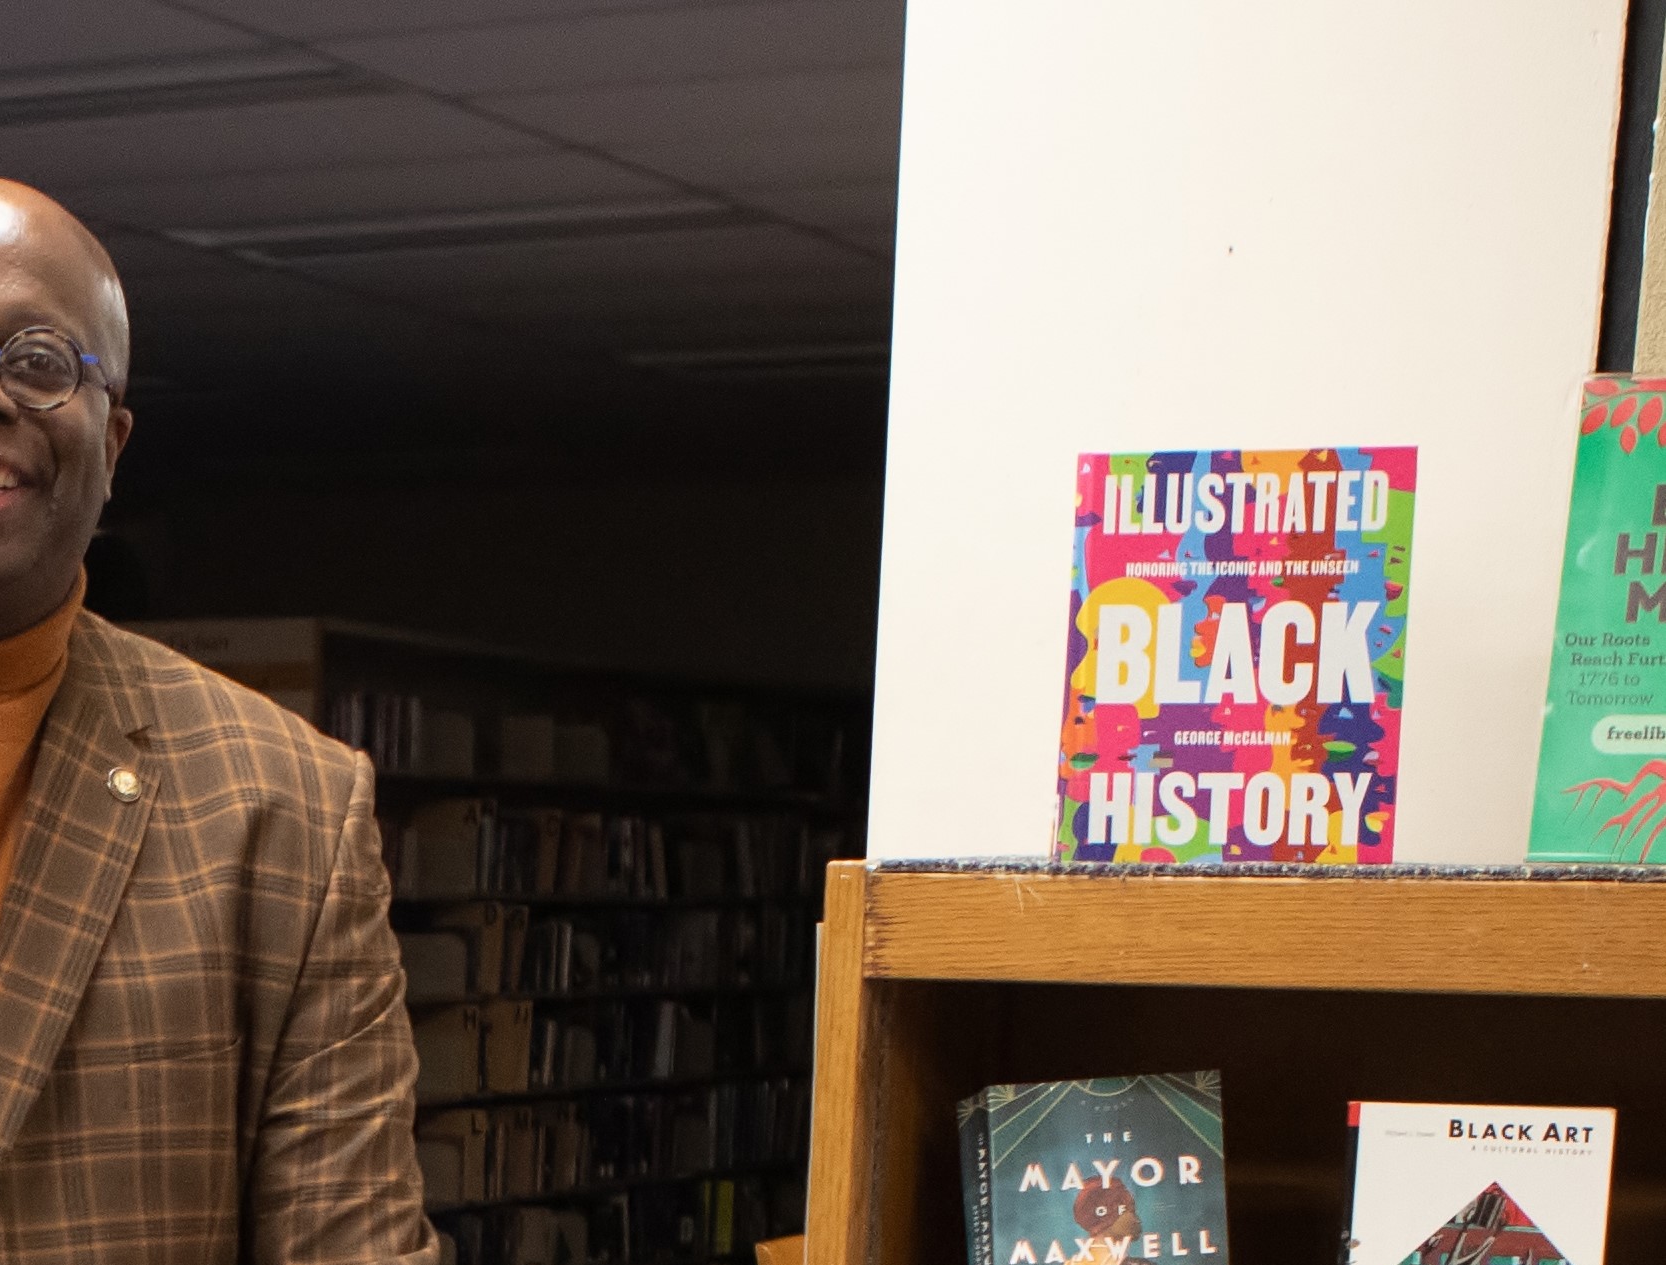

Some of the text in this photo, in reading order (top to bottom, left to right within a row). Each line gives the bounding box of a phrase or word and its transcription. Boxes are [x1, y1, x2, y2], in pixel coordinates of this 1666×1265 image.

[1103, 470, 1389, 535] ILLUSTRATED
[1125, 559, 1360, 578] HONORING THE ICONIC AND THE UNSEEN
[1564, 632, 1651, 648] Our Roots
[1095, 600, 1381, 706] BLACK
[1577, 671, 1641, 687] 1776 to
[1567, 689, 1655, 707] Tomorrow
[1174, 731, 1221, 746] GEORGE
[1087, 771, 1373, 848] HISTORY
[1085, 1130, 1134, 1144] THE
[1448, 1118, 1534, 1142] BLACK
[1540, 1121, 1596, 1144] ART
[1018, 1155, 1204, 1193] MAYOR
[1094, 1204, 1128, 1218] OF
[1008, 1229, 1218, 1265] MAXWELL
